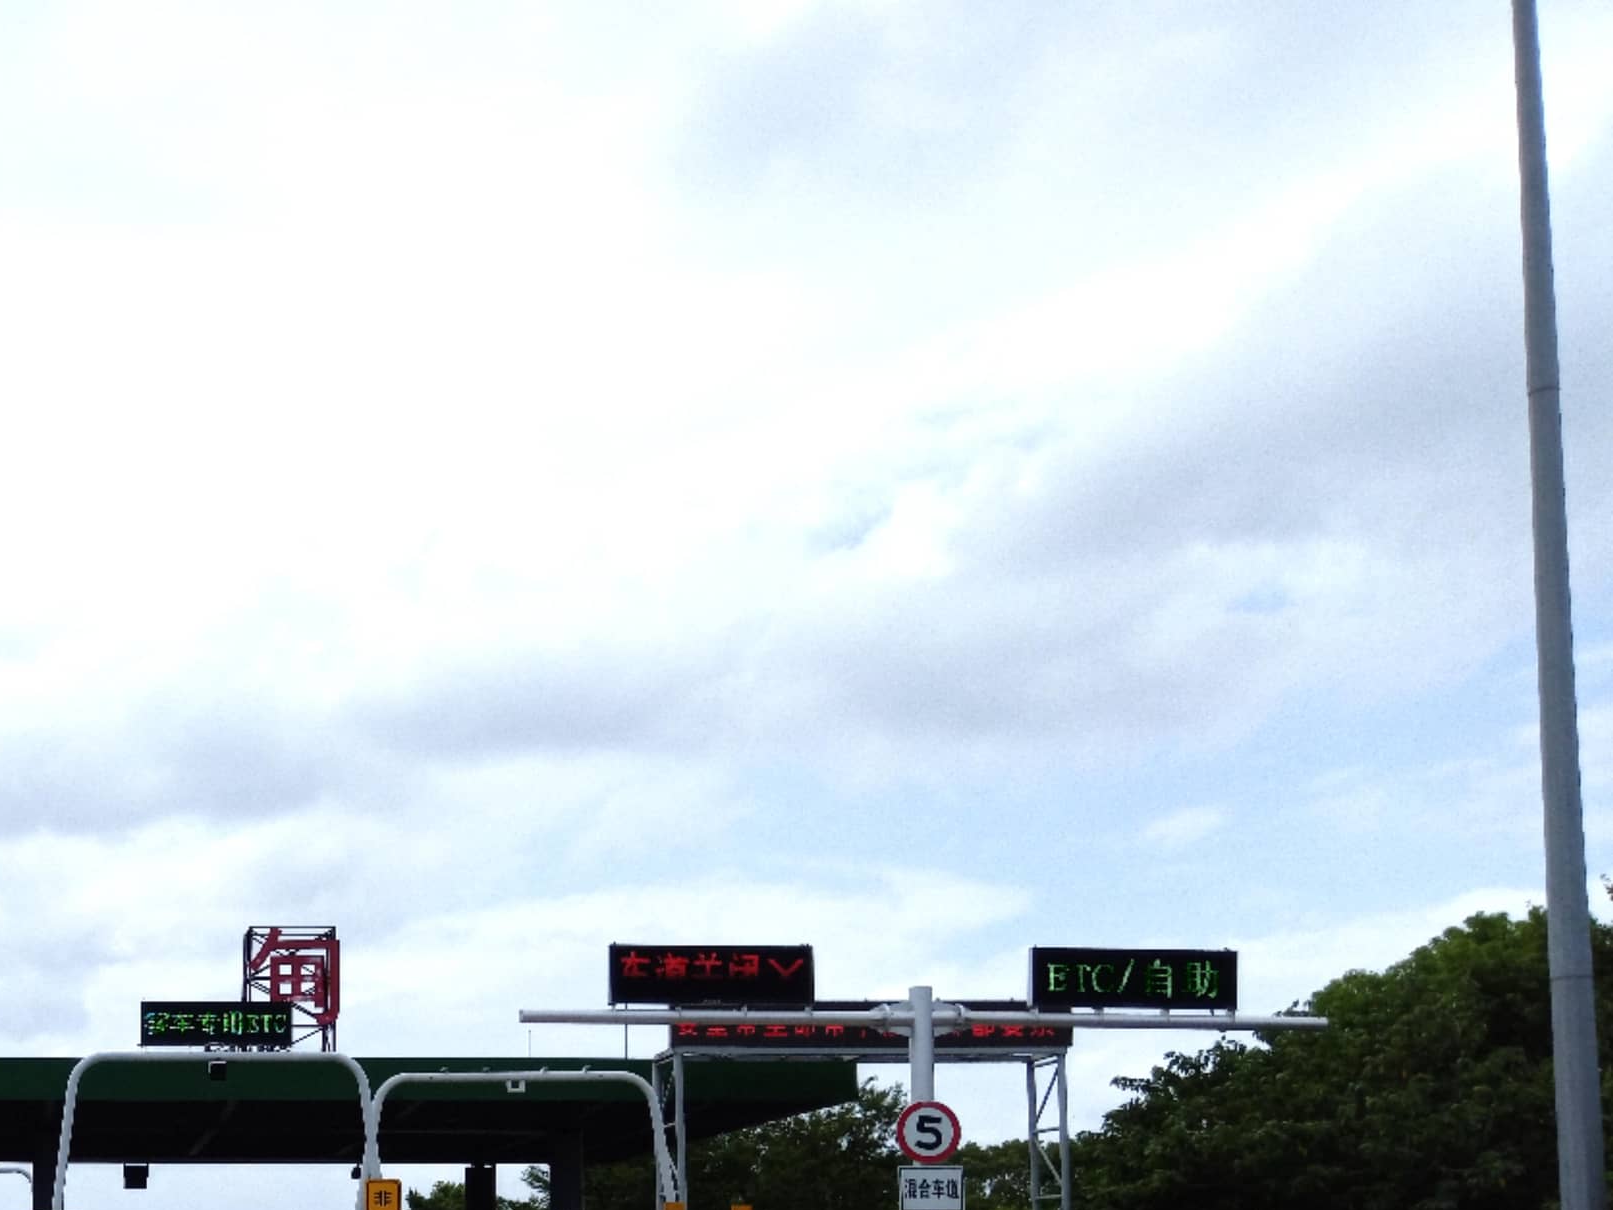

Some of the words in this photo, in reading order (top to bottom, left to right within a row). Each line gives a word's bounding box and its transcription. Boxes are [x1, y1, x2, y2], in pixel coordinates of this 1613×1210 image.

[915, 1115, 943, 1150] 5
[904, 1178, 960, 1199] 混合车道
